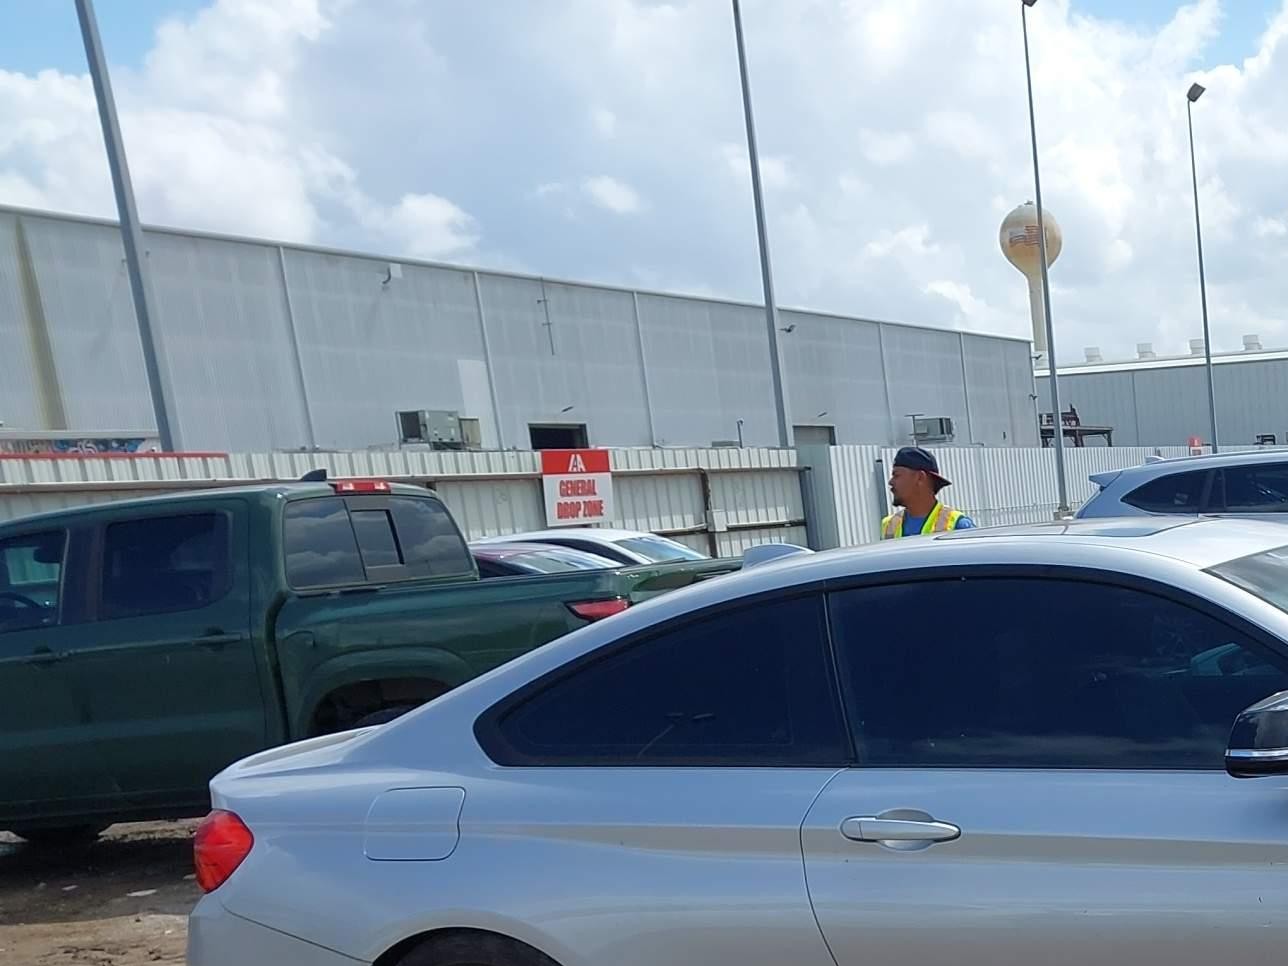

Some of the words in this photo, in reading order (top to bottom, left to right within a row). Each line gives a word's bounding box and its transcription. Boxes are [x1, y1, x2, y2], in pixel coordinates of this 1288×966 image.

[559, 479, 597, 497] GENERAL
[557, 501, 582, 519] DROP
[583, 500, 604, 518] ZONE
